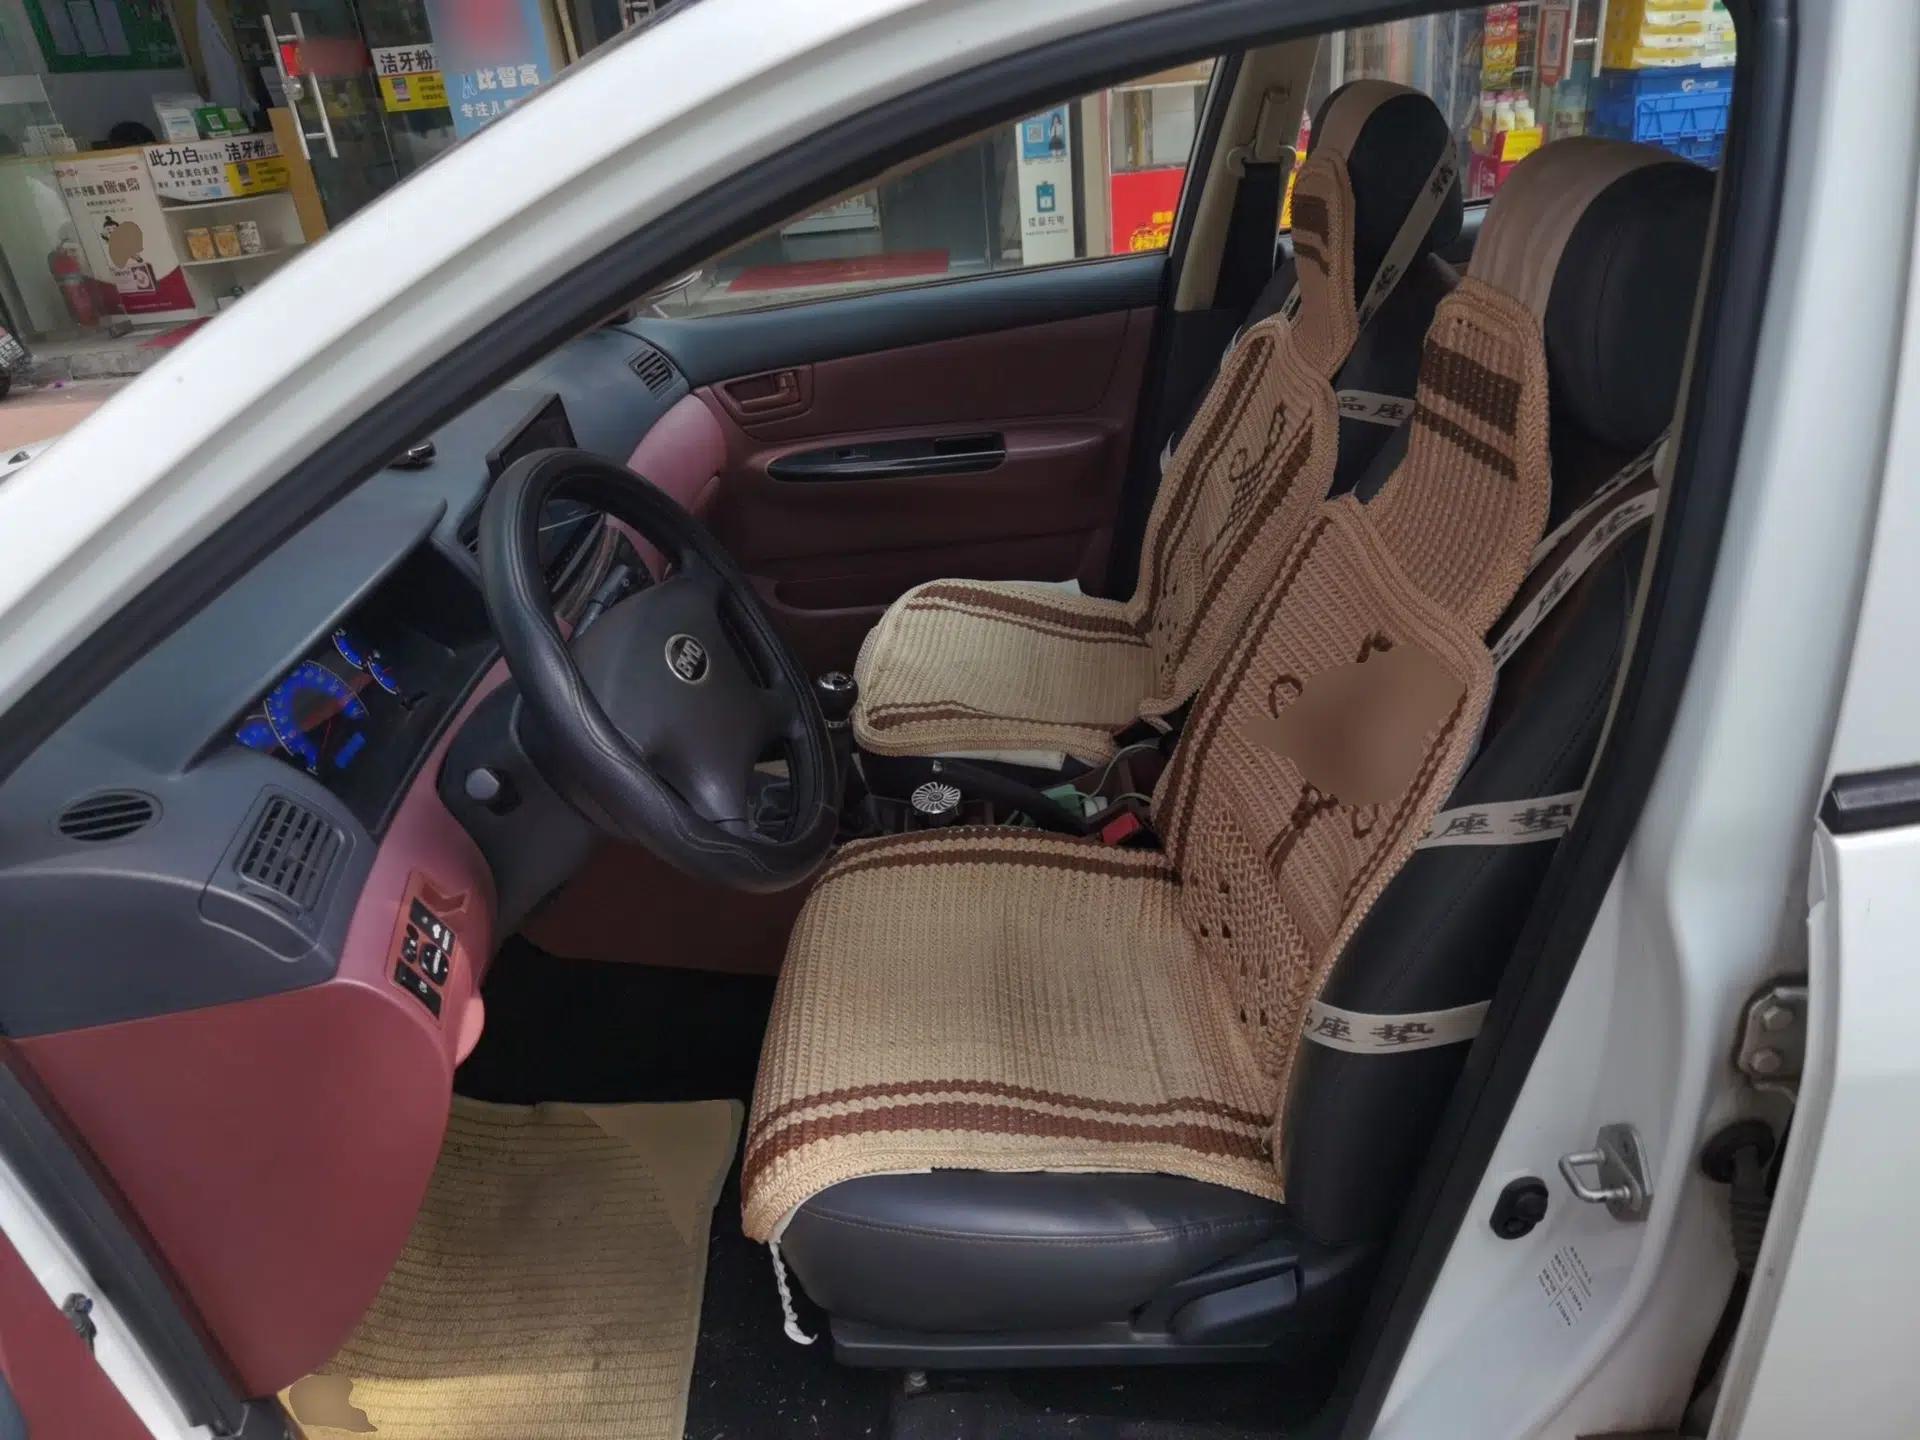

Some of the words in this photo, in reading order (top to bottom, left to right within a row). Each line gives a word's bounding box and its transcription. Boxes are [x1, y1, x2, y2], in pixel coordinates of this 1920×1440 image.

[380, 49, 433, 74] 洁牙粉
[476, 63, 540, 91] 比智高
[149, 146, 200, 167] 此力白
[225, 139, 266, 161] 洁牙粉
